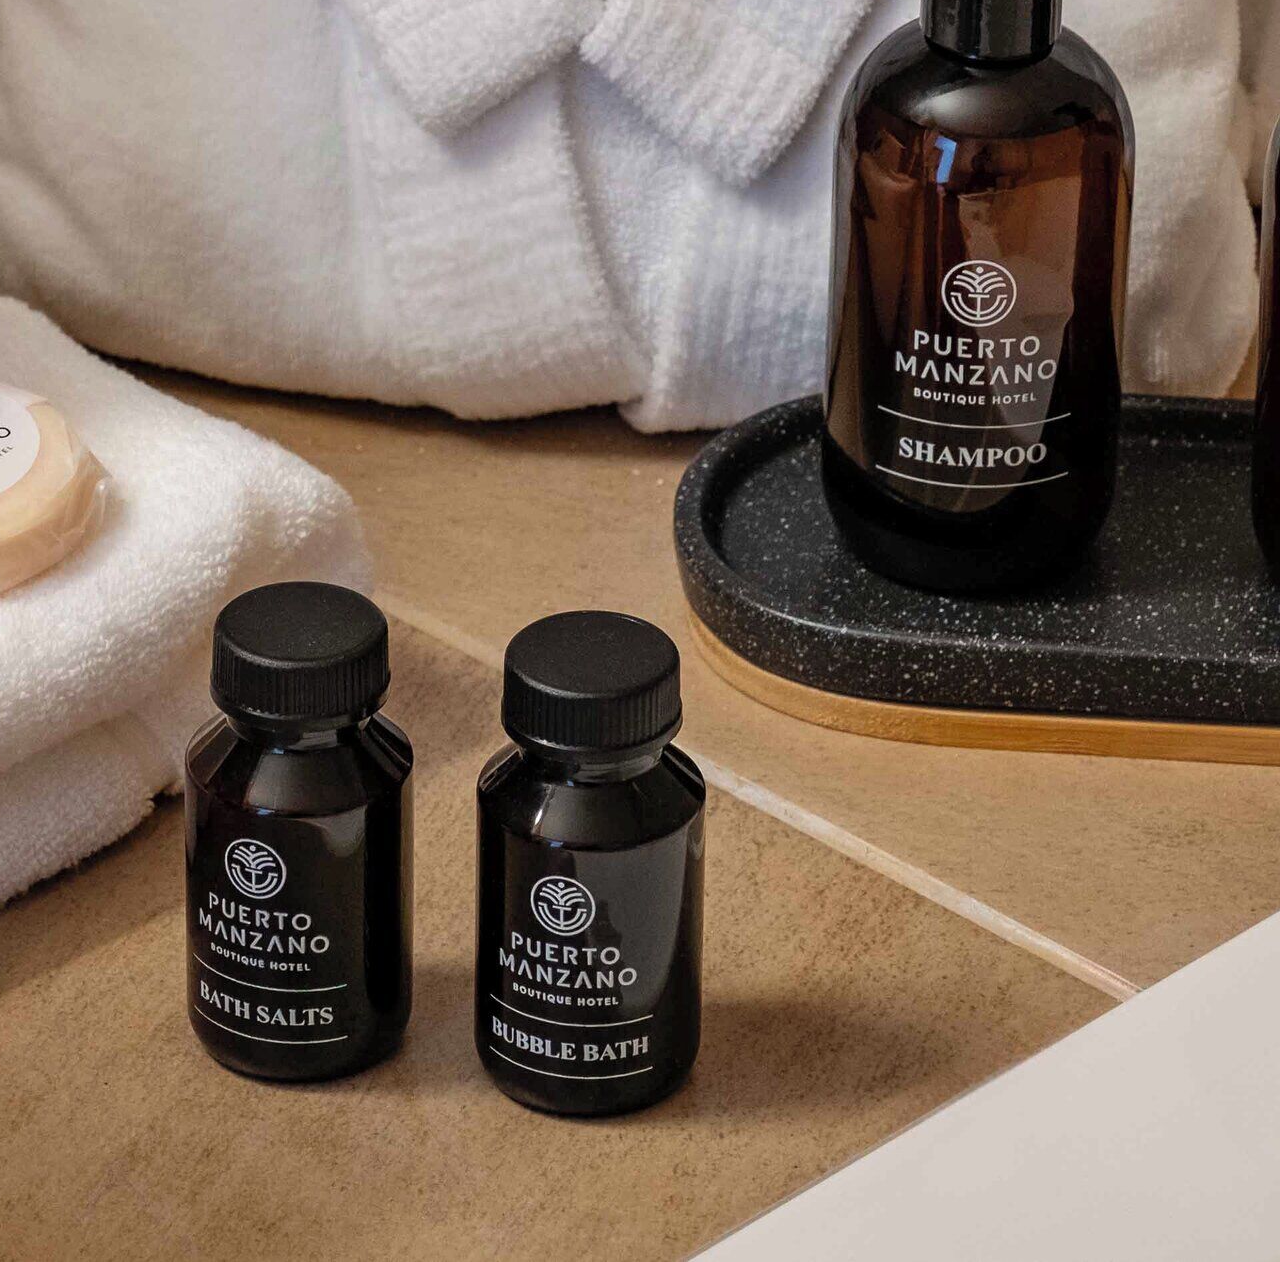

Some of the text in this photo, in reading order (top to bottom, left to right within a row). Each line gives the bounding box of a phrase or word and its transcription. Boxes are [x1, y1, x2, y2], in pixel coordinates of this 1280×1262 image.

[914, 329, 1041, 359] PUERTO
[895, 350, 1057, 386] MANZANO
[913, 387, 1036, 406] BOUTIQUE HOTEL
[898, 437, 1047, 468] SHAMPOO
[208, 891, 312, 931] PUERTO
[199, 907, 330, 955] MANZANO
[511, 931, 620, 966] PUERTO
[210, 942, 311, 972] BOUTIQUE HOTEL
[499, 947, 637, 989] MANZANO
[200, 980, 334, 1026] BATH SALTS
[512, 982, 619, 1007] BOUTIQUE HOTEL
[492, 1015, 649, 1062] BUBBLE BATH
